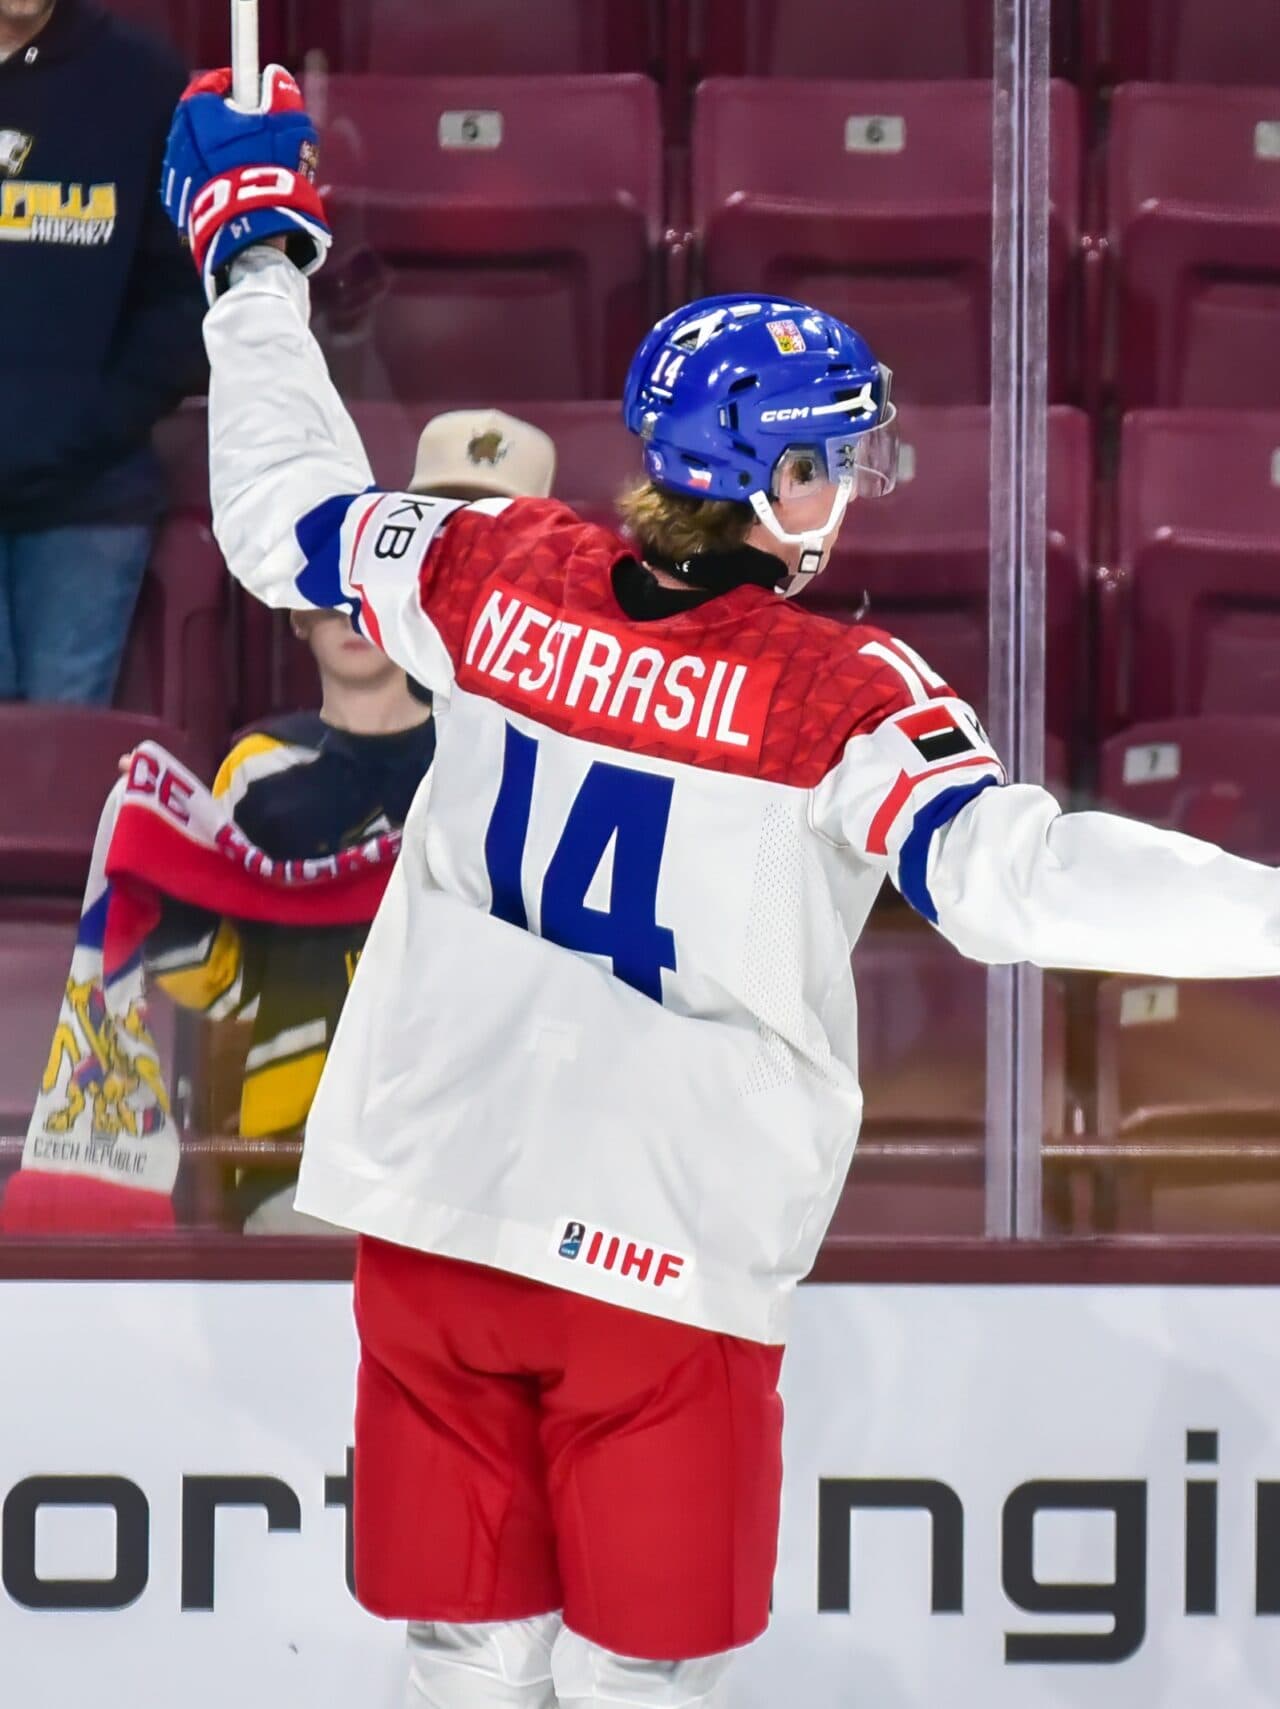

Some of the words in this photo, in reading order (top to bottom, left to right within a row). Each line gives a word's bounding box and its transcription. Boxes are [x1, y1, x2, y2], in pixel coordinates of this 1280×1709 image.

[651, 350, 686, 387] 14
[760, 406, 810, 423] CCM
[374, 499, 436, 559] KB
[465, 590, 749, 746] NESTRASIL
[484, 718, 677, 1006] 14
[33, 1137, 80, 1162] CZECH
[84, 1143, 147, 1174] REPUBLIC
[586, 1231, 685, 1287] IIHF
